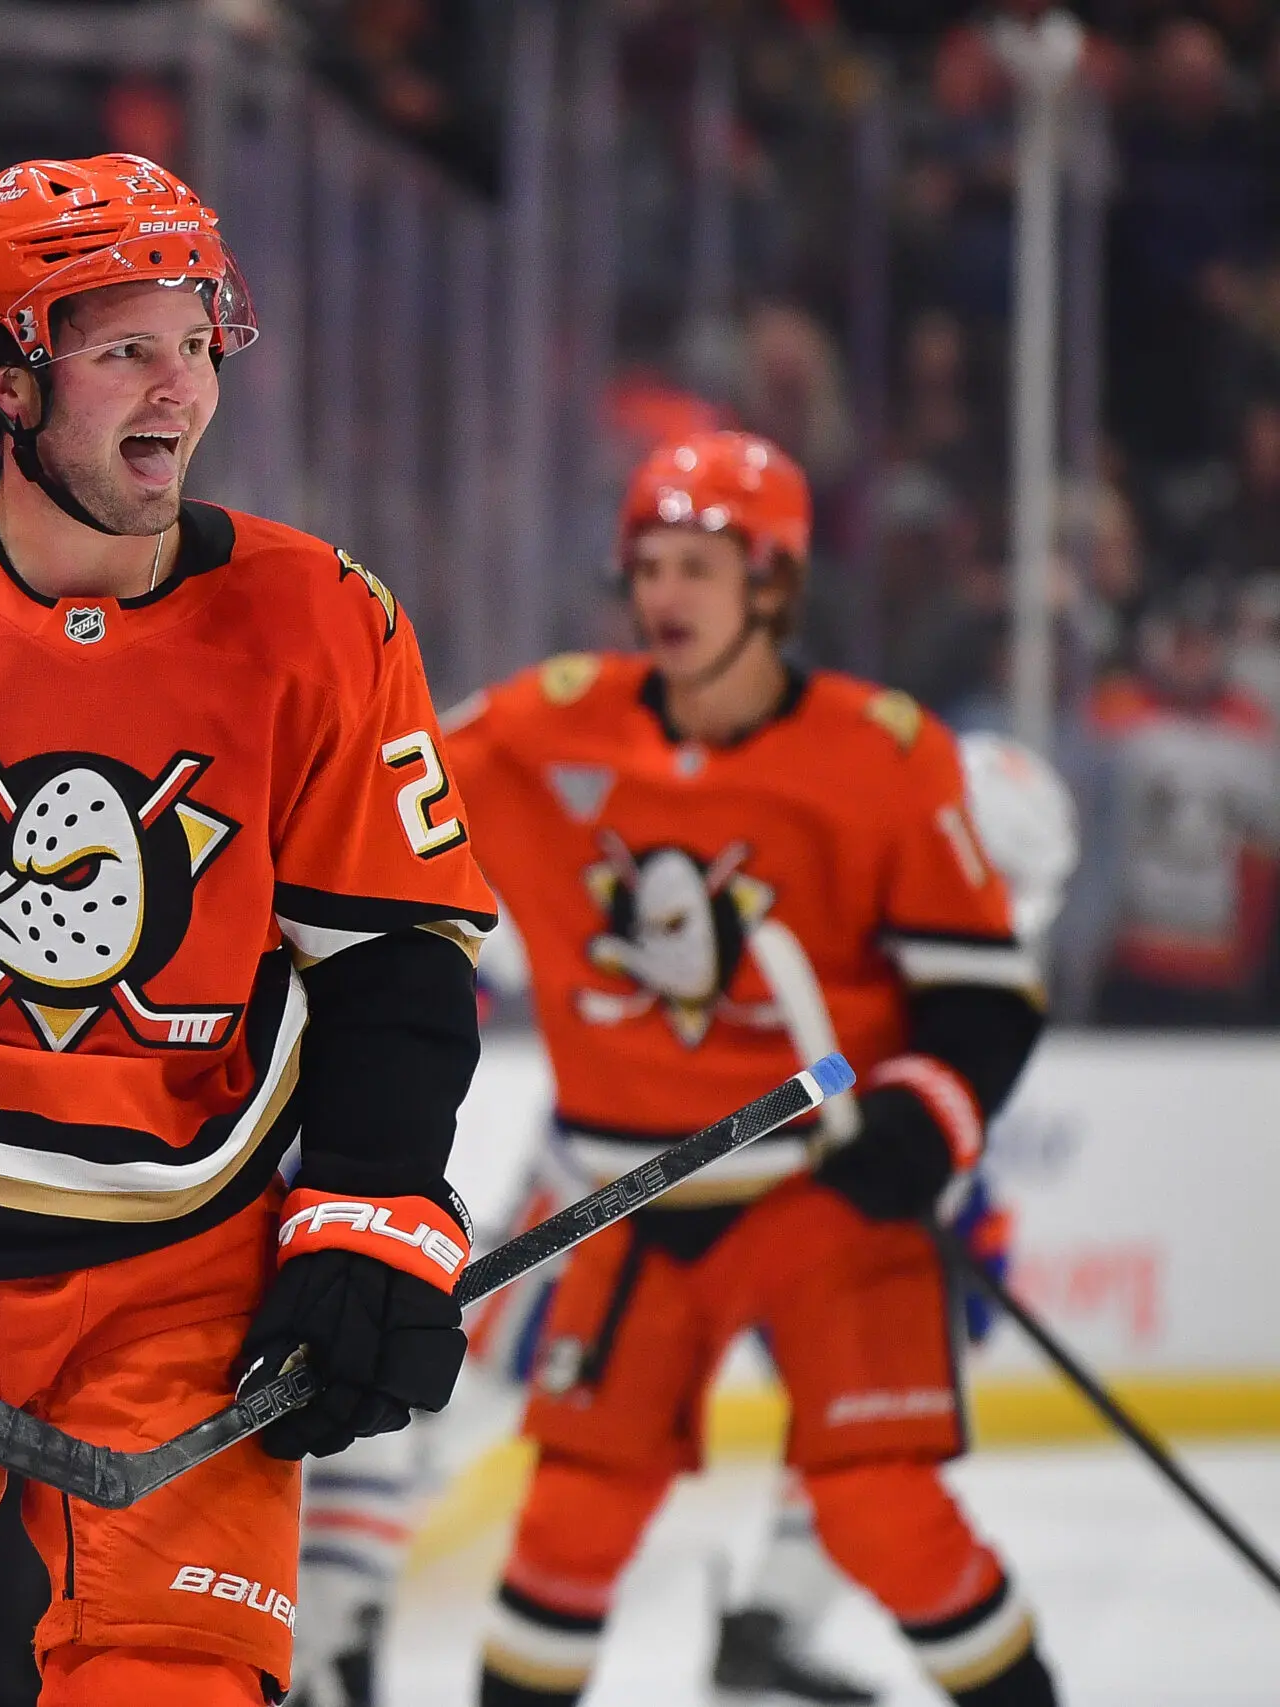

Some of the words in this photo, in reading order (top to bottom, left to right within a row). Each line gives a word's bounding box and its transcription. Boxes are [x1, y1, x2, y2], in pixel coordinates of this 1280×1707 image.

[73, 617, 98, 636] NHL
[382, 730, 465, 860] 2
[574, 1162, 670, 1227] TRUE
[278, 1201, 465, 1275] TRUE
